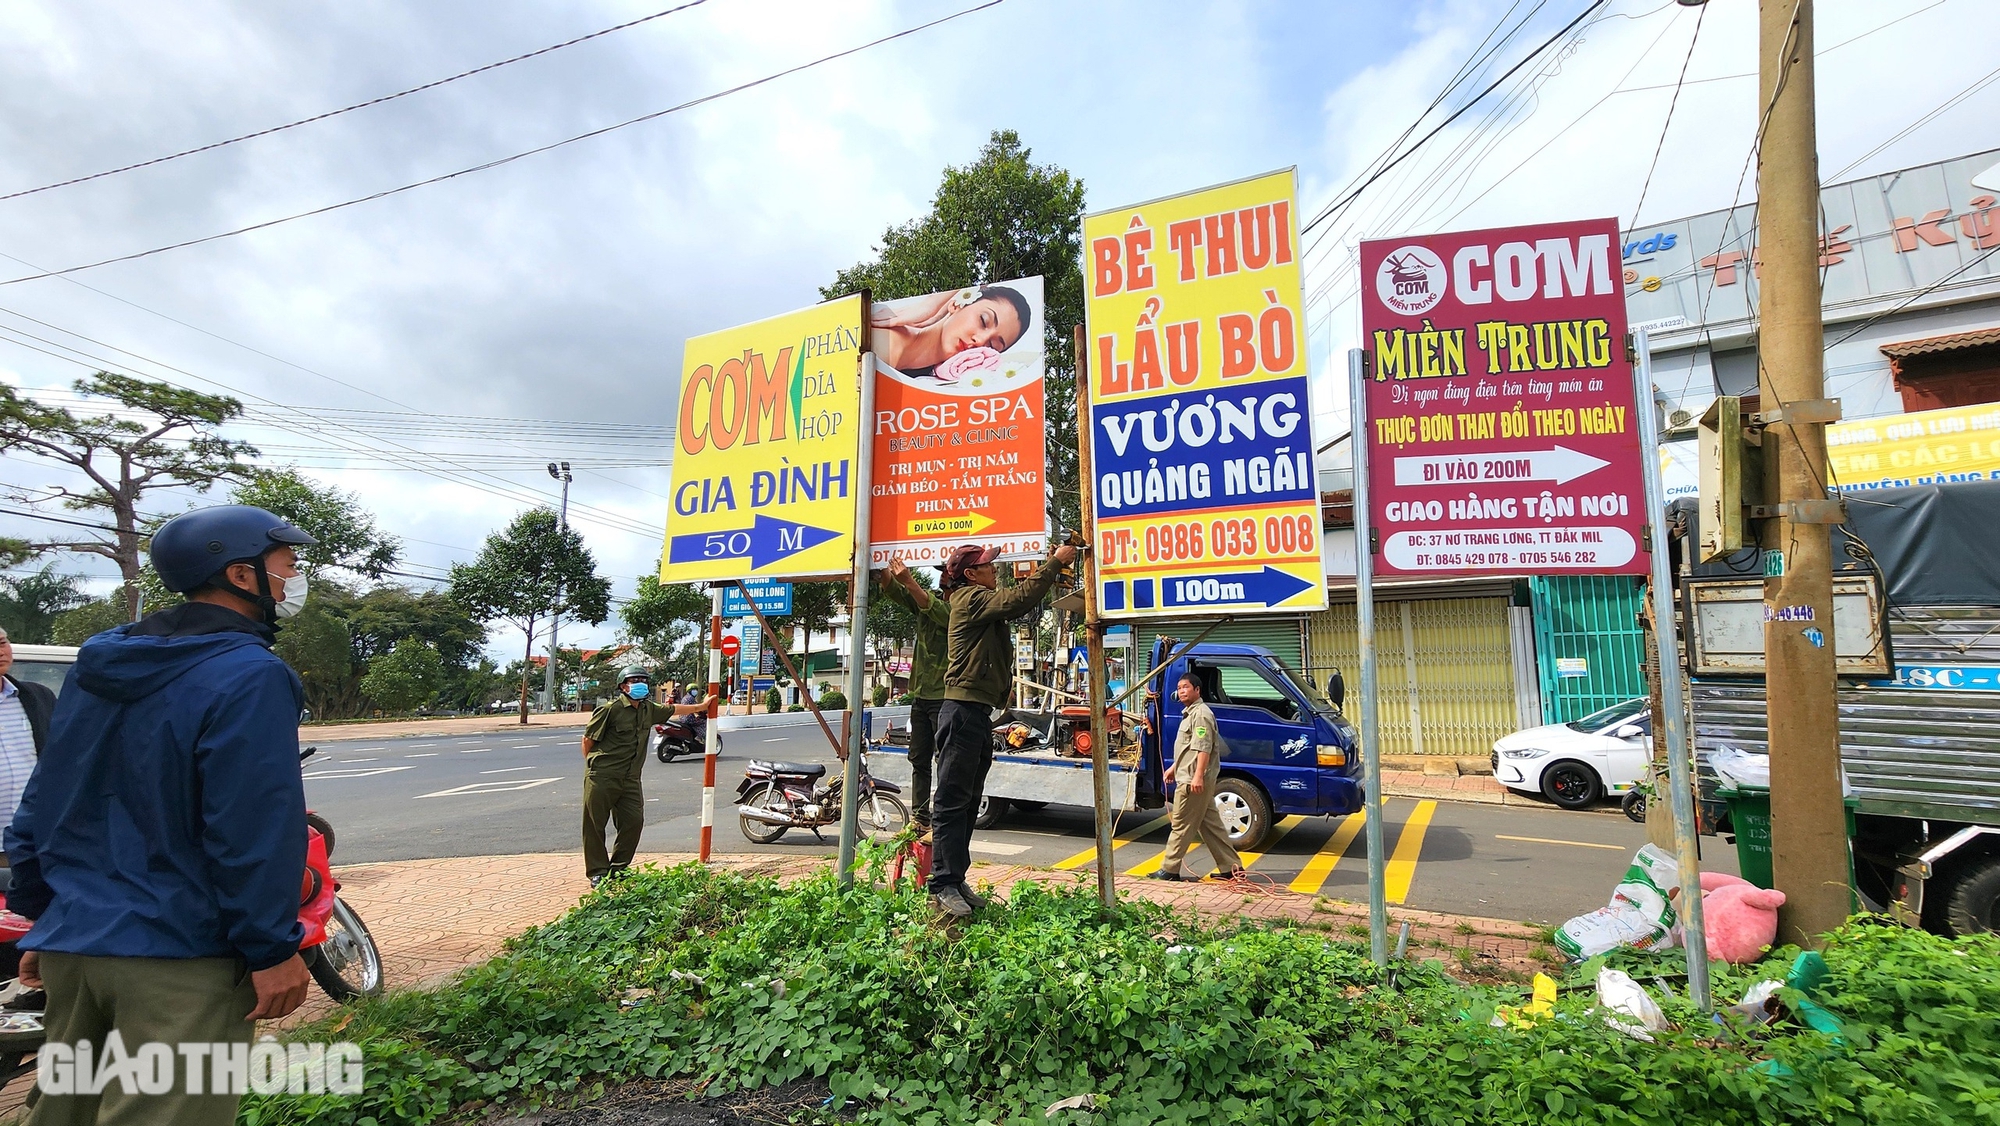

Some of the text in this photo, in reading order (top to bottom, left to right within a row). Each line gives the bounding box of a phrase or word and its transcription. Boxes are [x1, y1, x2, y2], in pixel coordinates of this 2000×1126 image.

[1092, 200, 1293, 298] BÊ THUI
[1453, 233, 1614, 305] CƠM
[1410, 293, 1437, 311] TRUNG
[1098, 288, 1296, 398] LẨU BÒ
[1373, 318, 1613, 381] MIỀN TRUNG
[680, 346, 794, 455] CƠM
[1392, 384, 1409, 405] Vị
[1444, 380, 1470, 407] đúng
[1503, 379, 1523, 396] trên
[1559, 377, 1582, 394] món
[1589, 377, 1603, 392] ăn
[801, 409, 843, 441] HỘP
[875, 394, 1034, 435] ROSE SPA
[1100, 391, 1301, 458] VƯƠNG
[1375, 401, 1626, 449] THỰC ĐƠN THAY ĐỔI THEO NGÀY
[1887, 420, 1925, 440] QUÀ
[889, 426, 1018, 452] BEAUTY & CLINIC
[889, 463, 912, 477] TRỊ
[916, 459, 946, 475] MỤN
[957, 456, 982, 471] TRỊ
[985, 450, 1018, 466] NÁM
[1423, 458, 1532, 481] ĐI VÀO 200M
[1890, 443, 1959, 468] CÁC
[674, 456, 849, 517] GIA ĐÌNH
[872, 481, 907, 497] GIẢM
[910, 478, 939, 493] BÉO
[950, 471, 982, 490] TẮM
[986, 467, 1037, 485] TRẮNG
[1100, 446, 1309, 511] QUẢNG NGÃI
[915, 494, 989, 513] PHUN XĂM
[1385, 490, 1628, 523] GIAO HÀNG TẬN NƠI
[703, 526, 806, 557] 50 M
[914, 520, 973, 532] ĐI VÀO 100M
[1101, 514, 1314, 566] ĐT: 0986 033 008
[1408, 535, 1426, 547] ĐC:
[1429, 534, 1442, 546] 37
[1445, 533, 1461, 546] NƠ
[1464, 532, 1499, 545] TRANG
[1539, 532, 1551, 543] TT
[1554, 527, 1578, 543] ĐẮK
[1582, 532, 1603, 543] MIL
[1417, 554, 1432, 566] ĐT:
[1435, 554, 1462, 565] 0845
[1465, 553, 1485, 565] 429
[1488, 553, 1509, 564] 078
[1519, 552, 1547, 564] 0705
[1550, 552, 1572, 563] 546
[1575, 551, 1596, 563] 282
[1175, 578, 1245, 602] 100m
